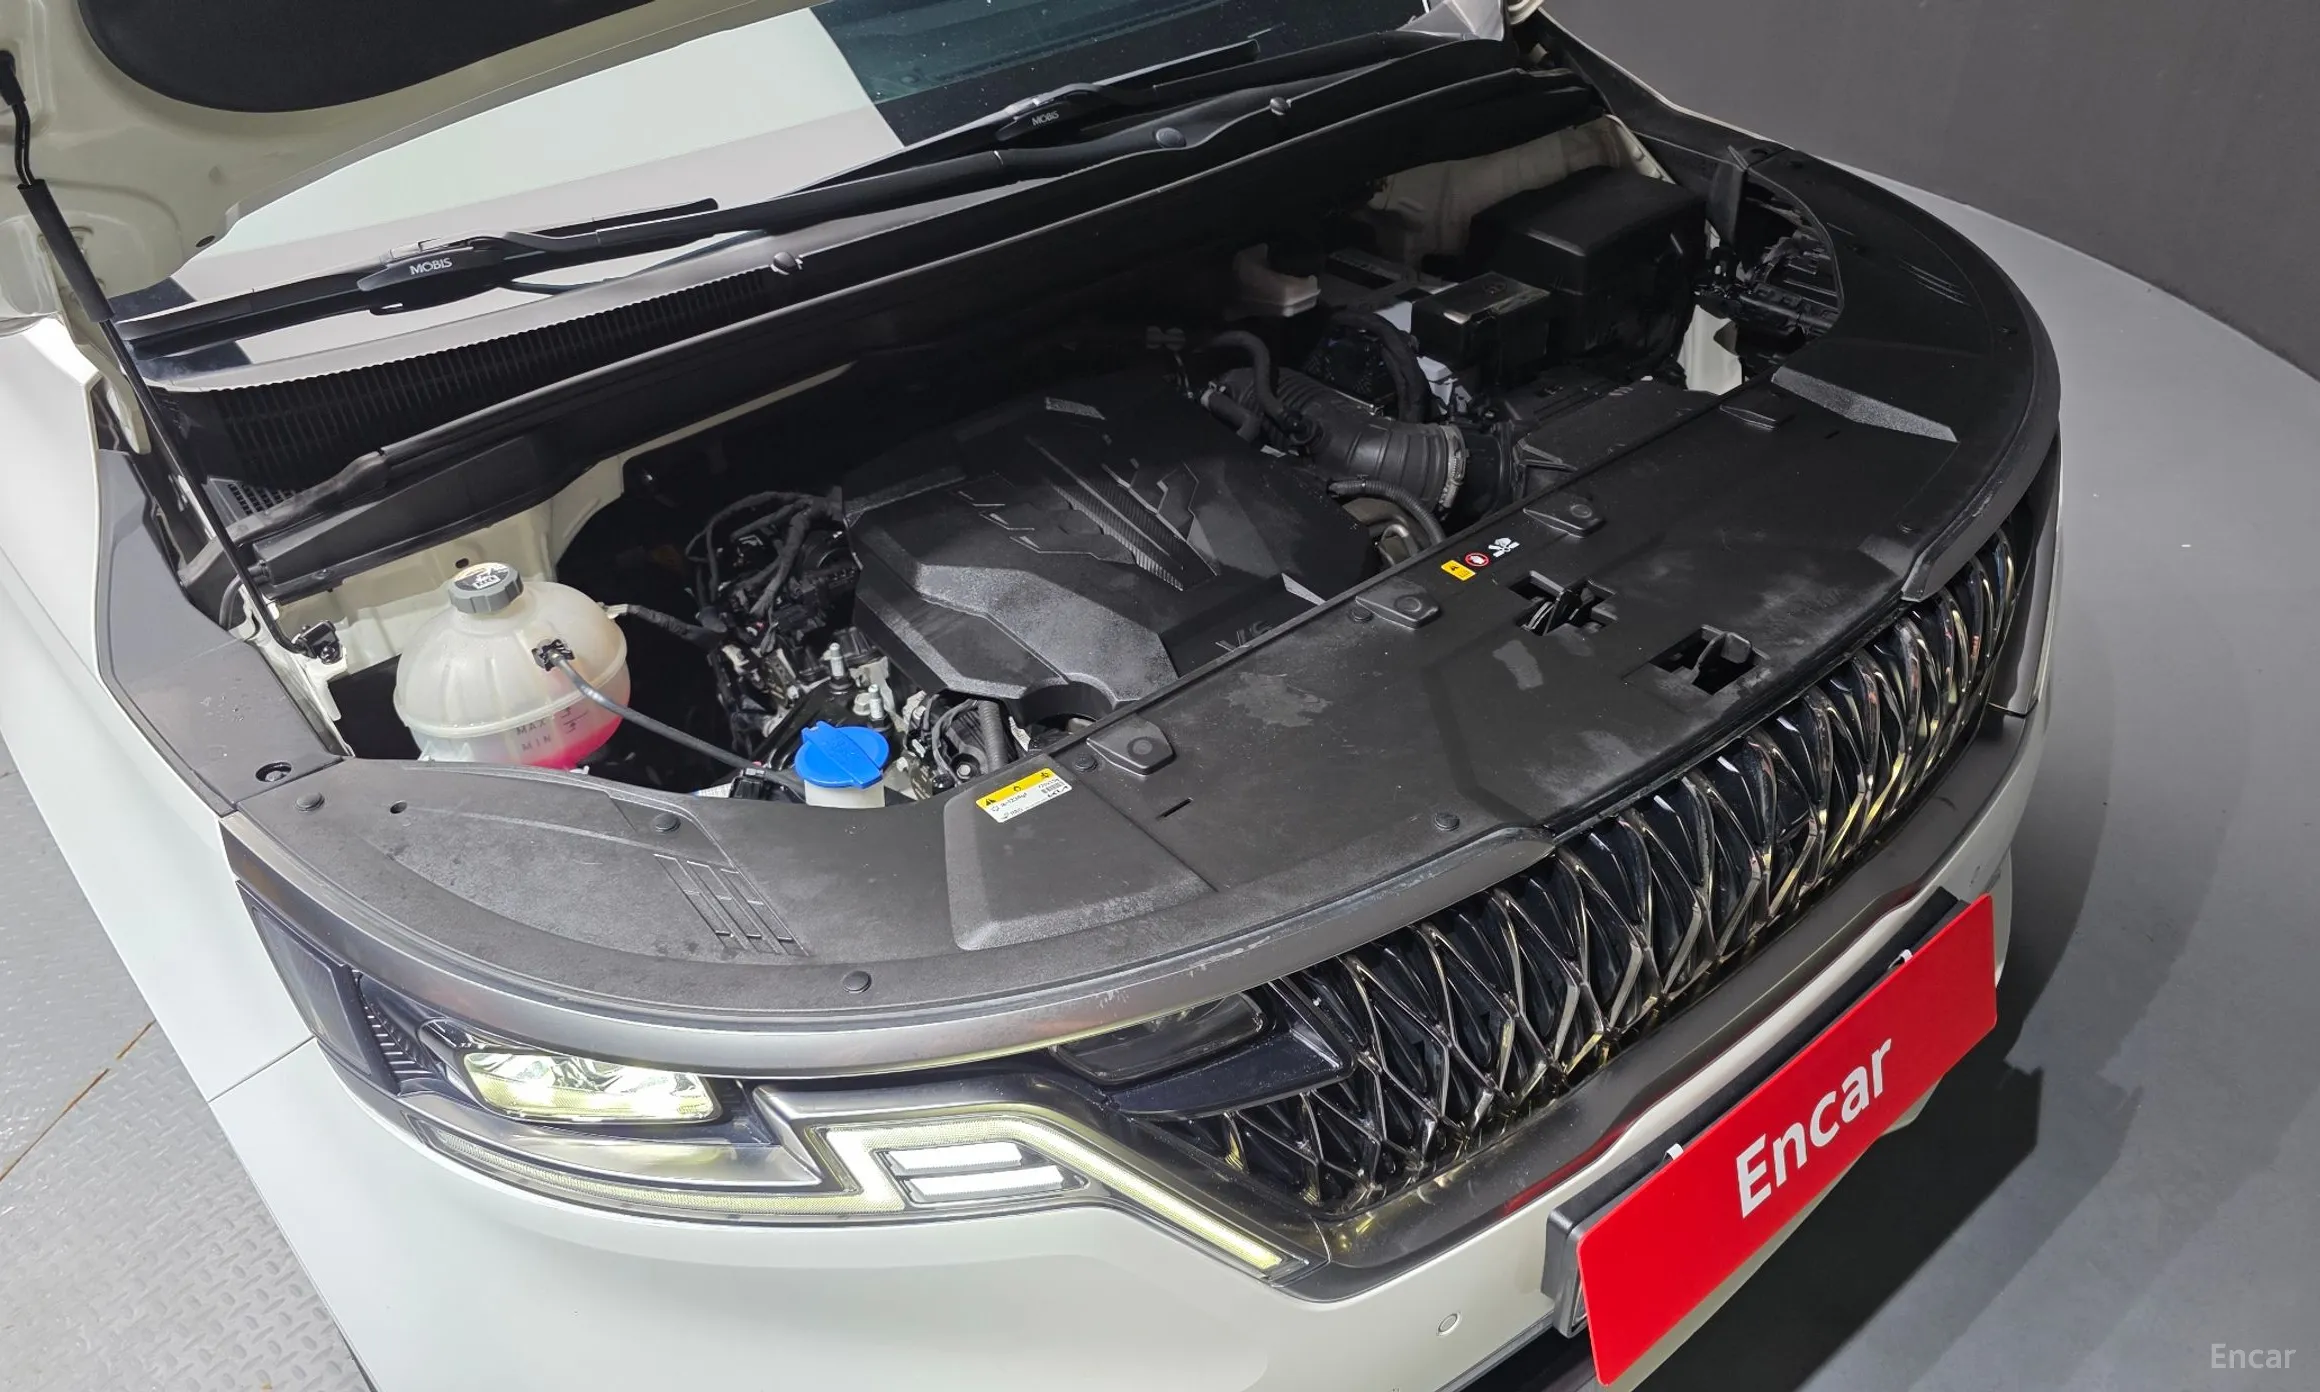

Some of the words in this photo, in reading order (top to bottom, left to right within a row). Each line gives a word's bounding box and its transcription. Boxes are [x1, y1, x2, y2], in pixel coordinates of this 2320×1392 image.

[409, 257, 453, 275] MOBIS
[516, 719, 547, 735] MAX
[521, 735, 551, 751] MIN
[1736, 1038, 1892, 1219] Encar
